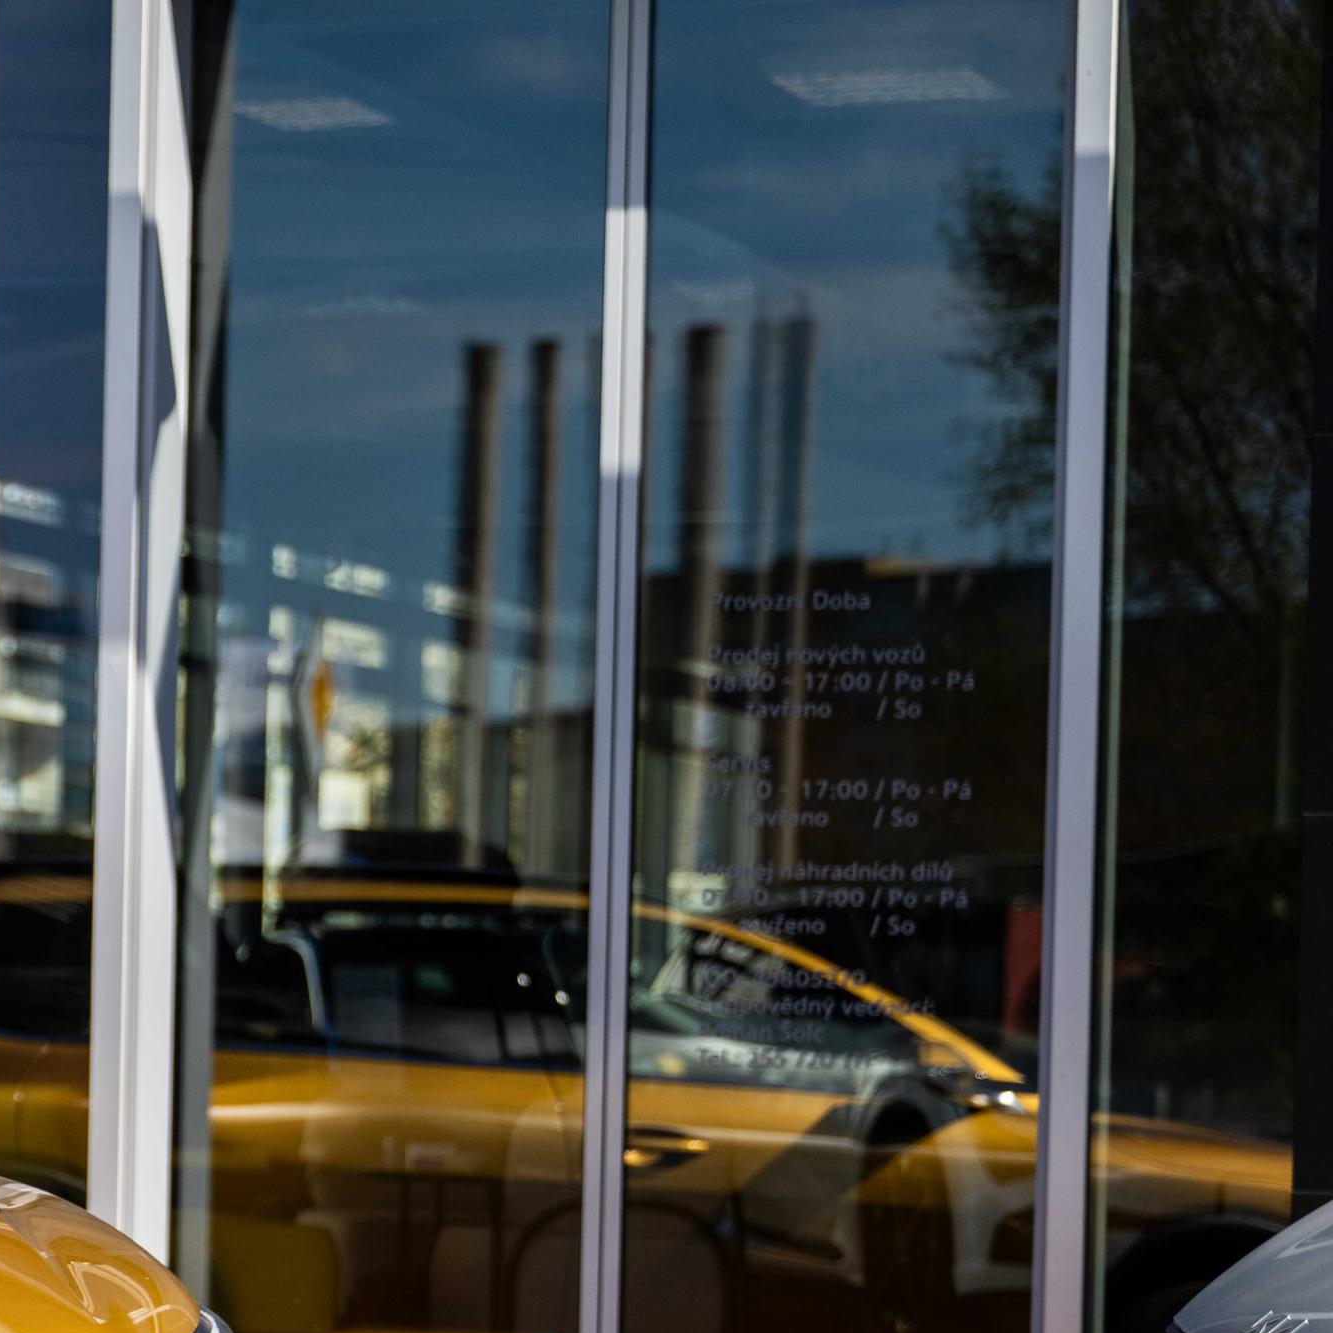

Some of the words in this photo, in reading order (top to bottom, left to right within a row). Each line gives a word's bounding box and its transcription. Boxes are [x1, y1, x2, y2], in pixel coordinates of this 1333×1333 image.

[812, 589, 872, 610] Doba
[708, 644, 780, 667] Prodej
[786, 642, 867, 667] nových
[872, 640, 925, 664] vozů
[895, 671, 924, 692] Po
[946, 670, 976, 692] Pá
[894, 699, 922, 720] So
[801, 778, 869, 799] 17:00
[890, 779, 921, 800] Po
[942, 777, 973, 800] Pá
[890, 807, 919, 828] So
[780, 860, 904, 883] náhradních
[910, 860, 954, 883] dílů
[887, 887, 917, 909] Po
[939, 886, 969, 909] Pá
[887, 915, 917, 936] So
